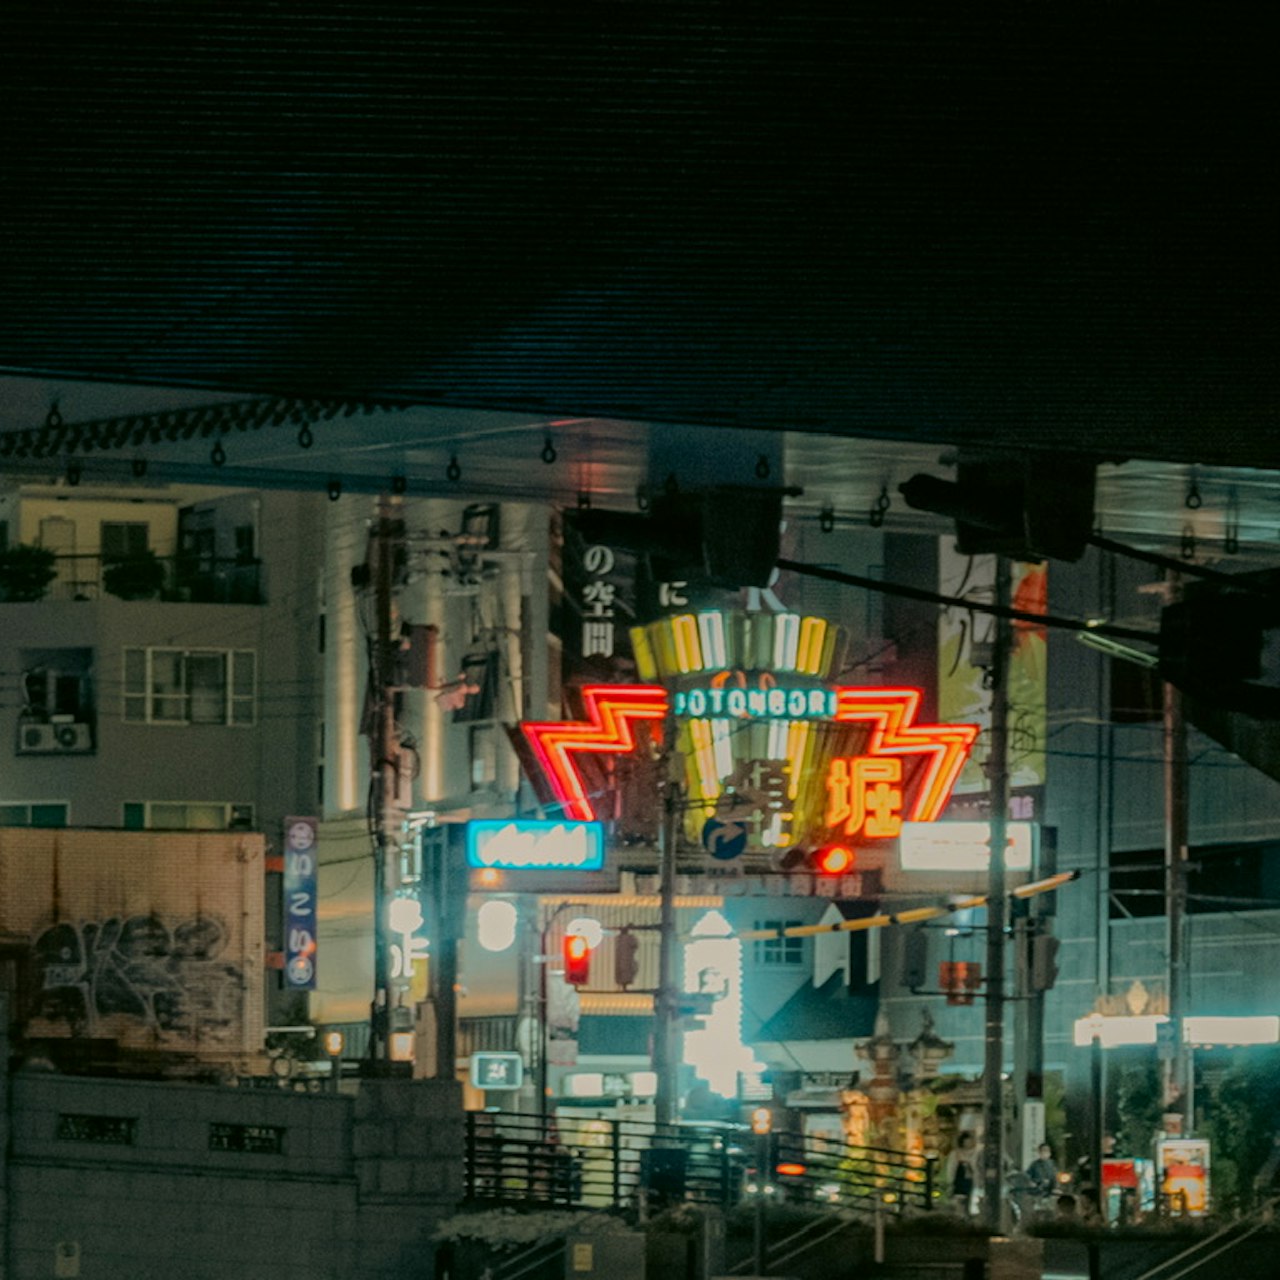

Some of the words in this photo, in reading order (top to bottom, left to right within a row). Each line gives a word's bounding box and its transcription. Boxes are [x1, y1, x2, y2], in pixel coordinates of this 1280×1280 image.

[582, 545, 615, 658] の空間
[659, 581, 688, 606] に
[825, 757, 902, 838] 堀
